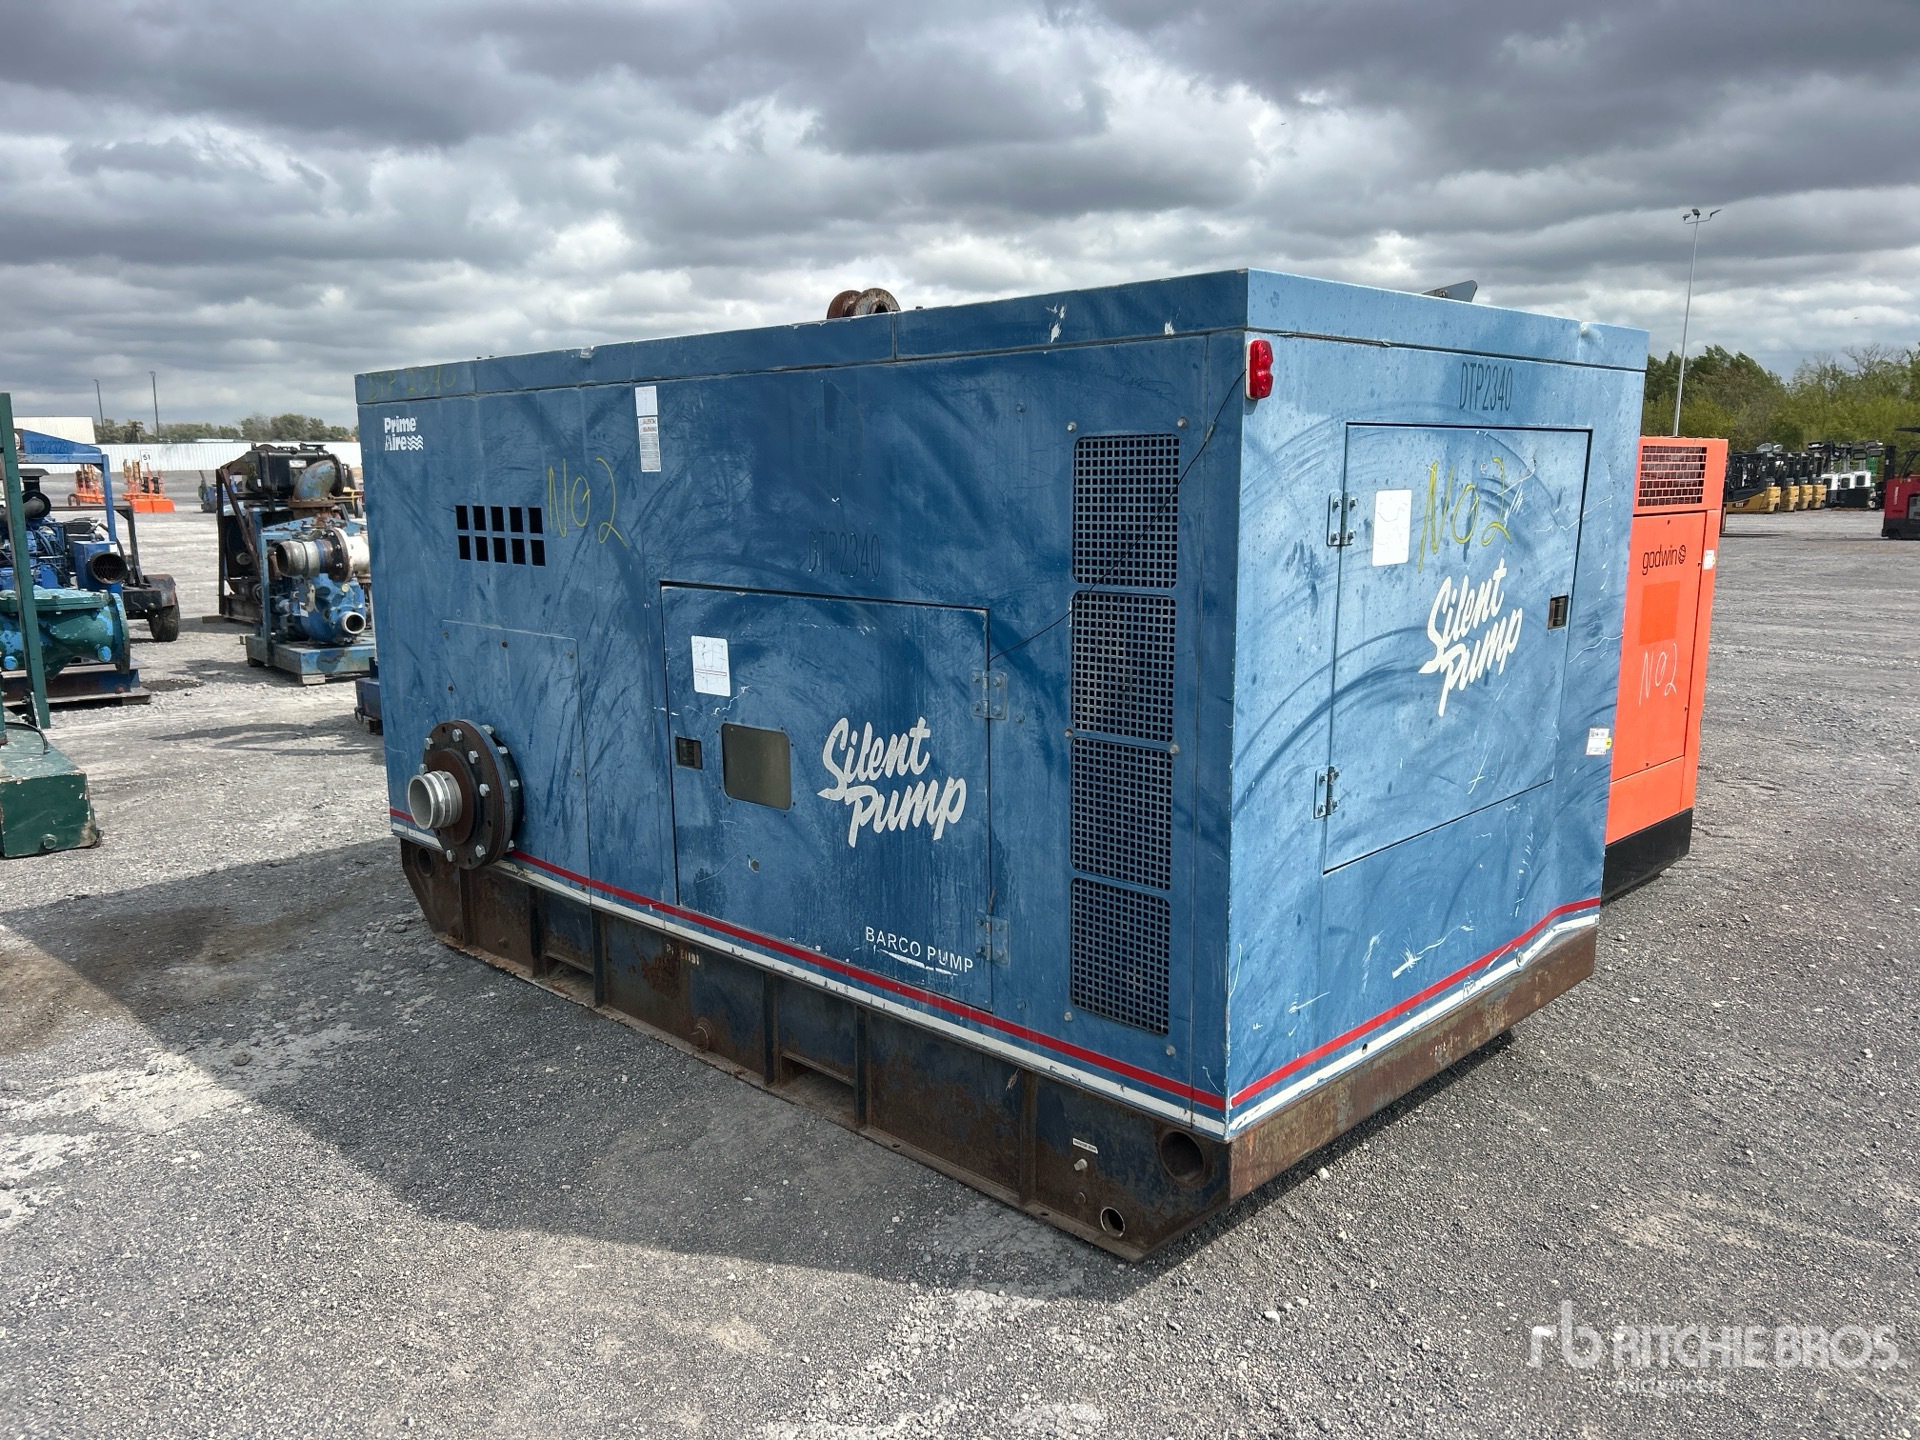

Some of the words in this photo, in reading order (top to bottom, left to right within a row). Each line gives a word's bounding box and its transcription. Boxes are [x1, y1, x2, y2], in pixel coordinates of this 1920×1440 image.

[1458, 361, 1513, 412] DTP2340
[384, 416, 417, 434] Prime
[385, 434, 407, 451] Aire
[808, 530, 881, 578] DTP2340
[1642, 544, 1678, 576] godwin
[1418, 557, 1508, 674] Silent
[1438, 607, 1524, 718] Pump
[817, 716, 931, 801] Silent
[845, 776, 968, 848] Pump
[865, 925, 921, 957] BARCO
[927, 945, 974, 974] PUMP
